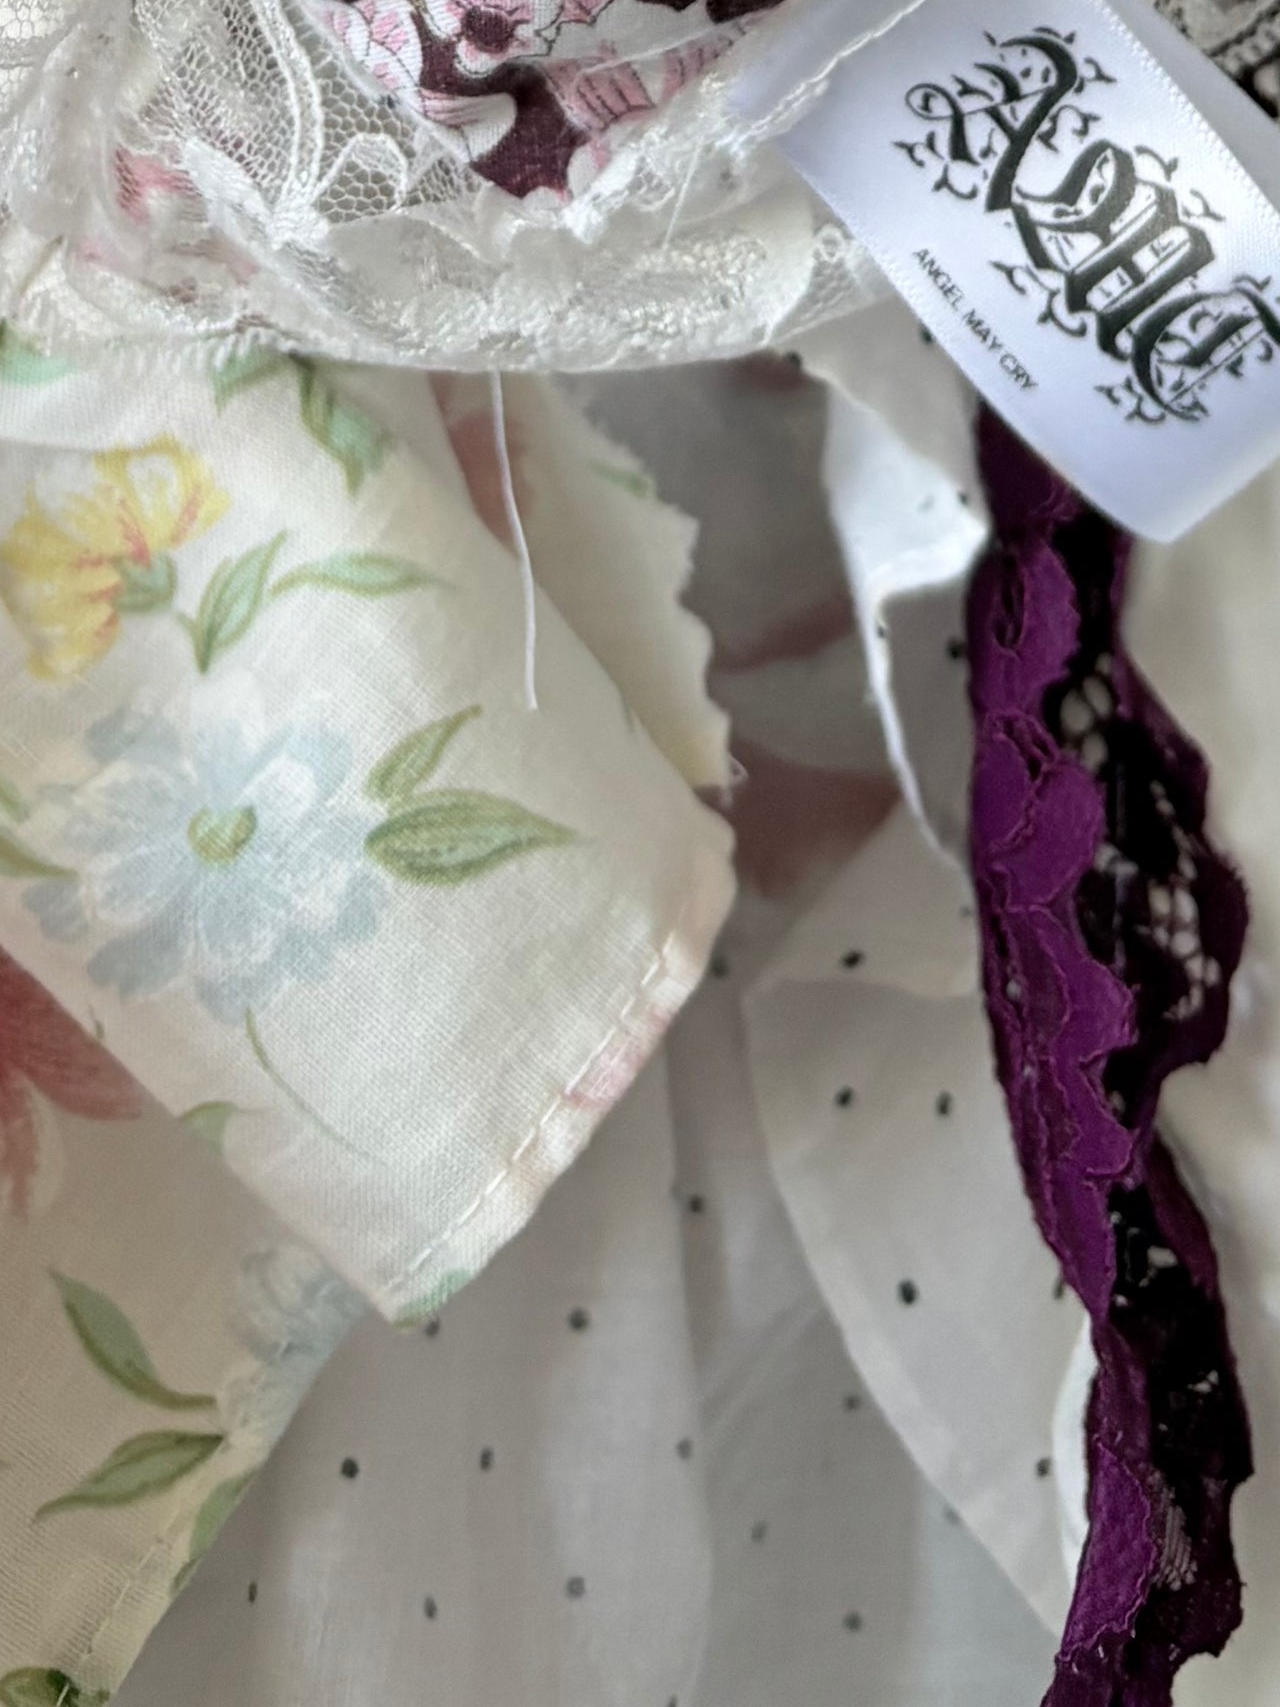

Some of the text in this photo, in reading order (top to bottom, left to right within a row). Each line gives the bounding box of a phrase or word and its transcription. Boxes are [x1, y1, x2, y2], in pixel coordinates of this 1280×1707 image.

[913, 248, 1039, 388] ANGEL MAY CRY
